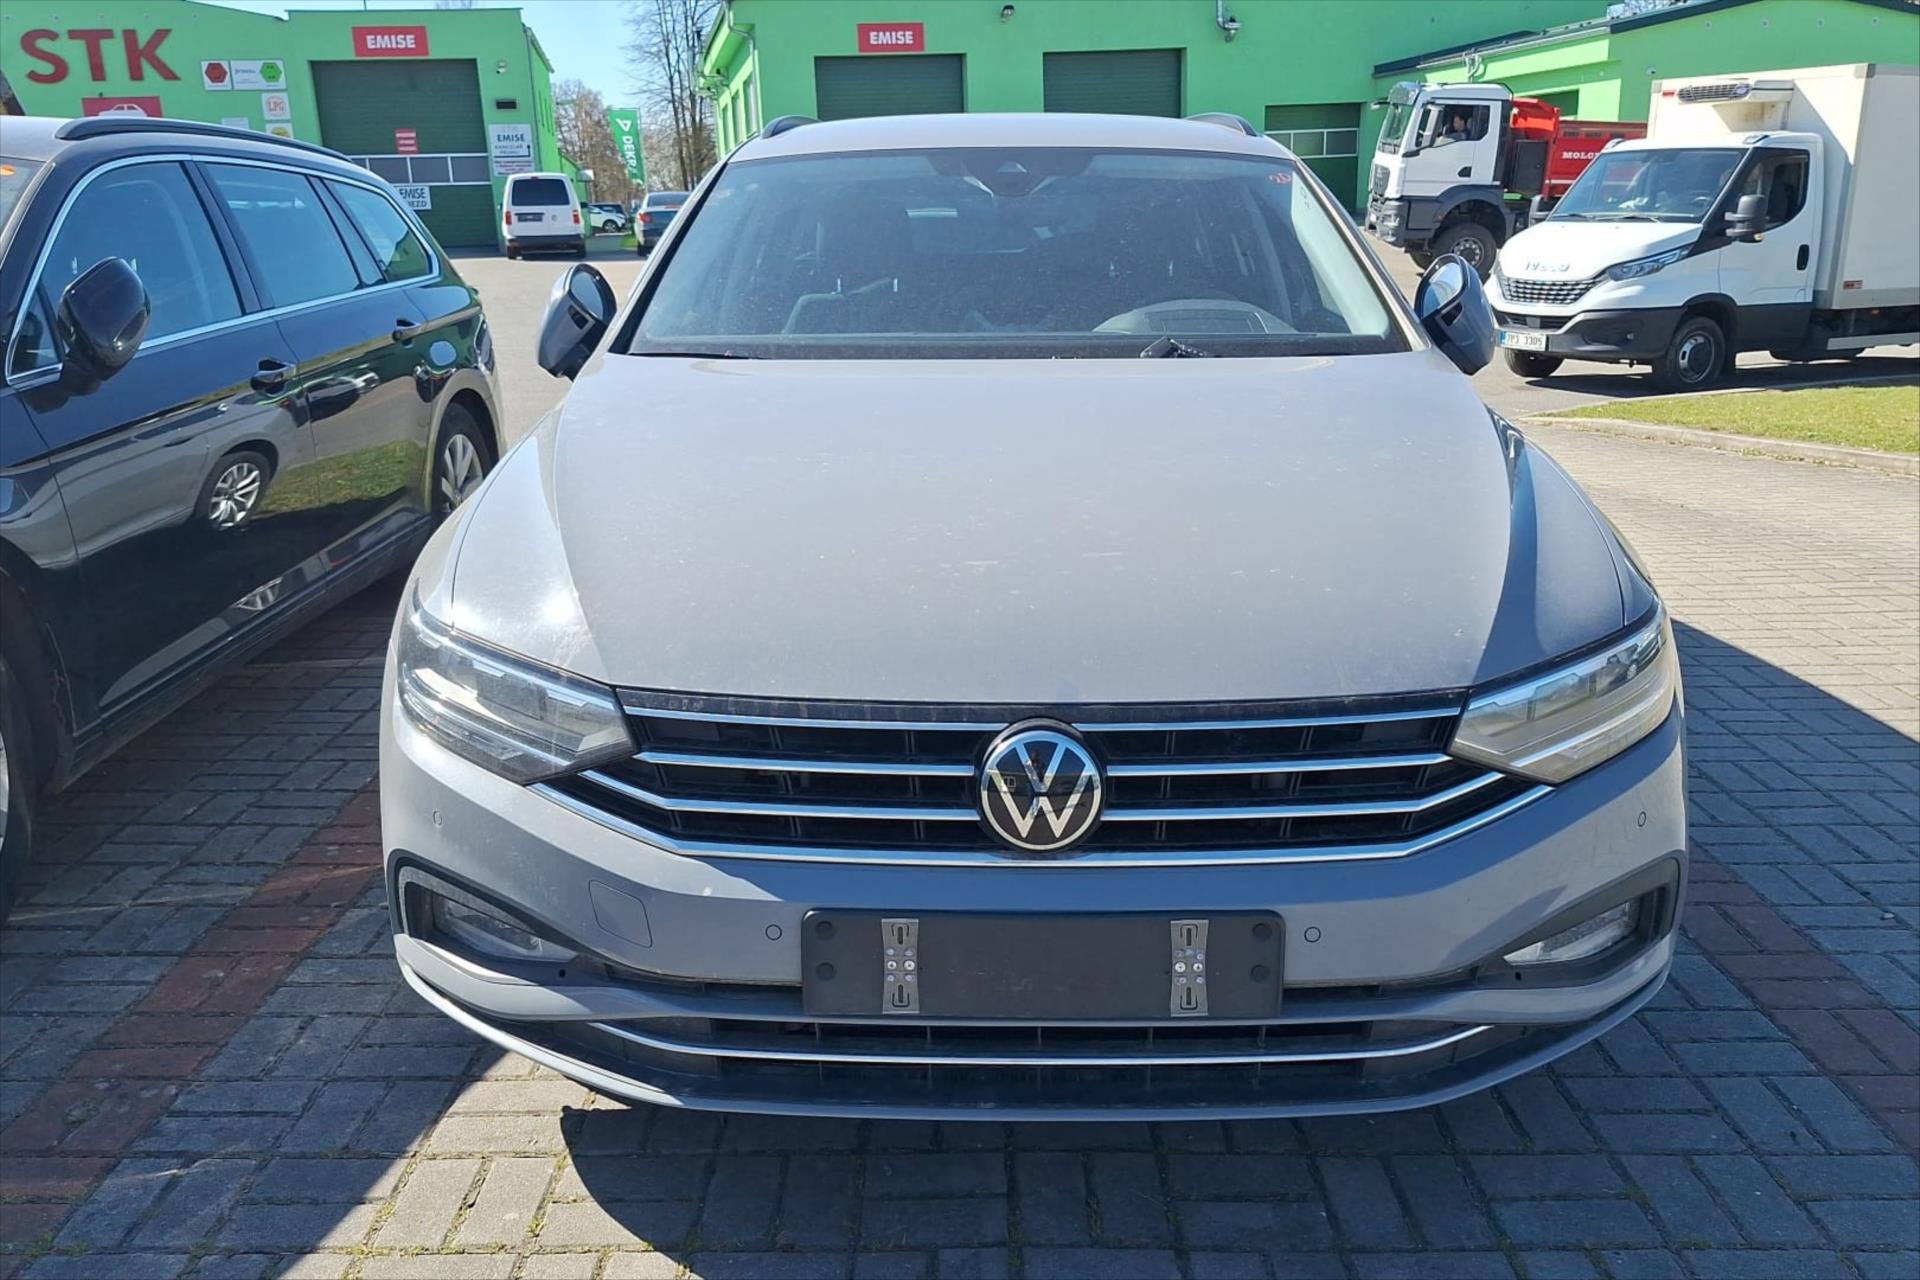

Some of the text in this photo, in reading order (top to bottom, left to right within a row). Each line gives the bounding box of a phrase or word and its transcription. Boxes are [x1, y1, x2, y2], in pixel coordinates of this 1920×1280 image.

[366, 34, 416, 49] EMISE
[869, 31, 914, 45] EMISE
[20, 28, 181, 84] STK
[497, 134, 525, 142] EMISE
[399, 188, 426, 199] EMISE
[985, 732, 1098, 846] VW
